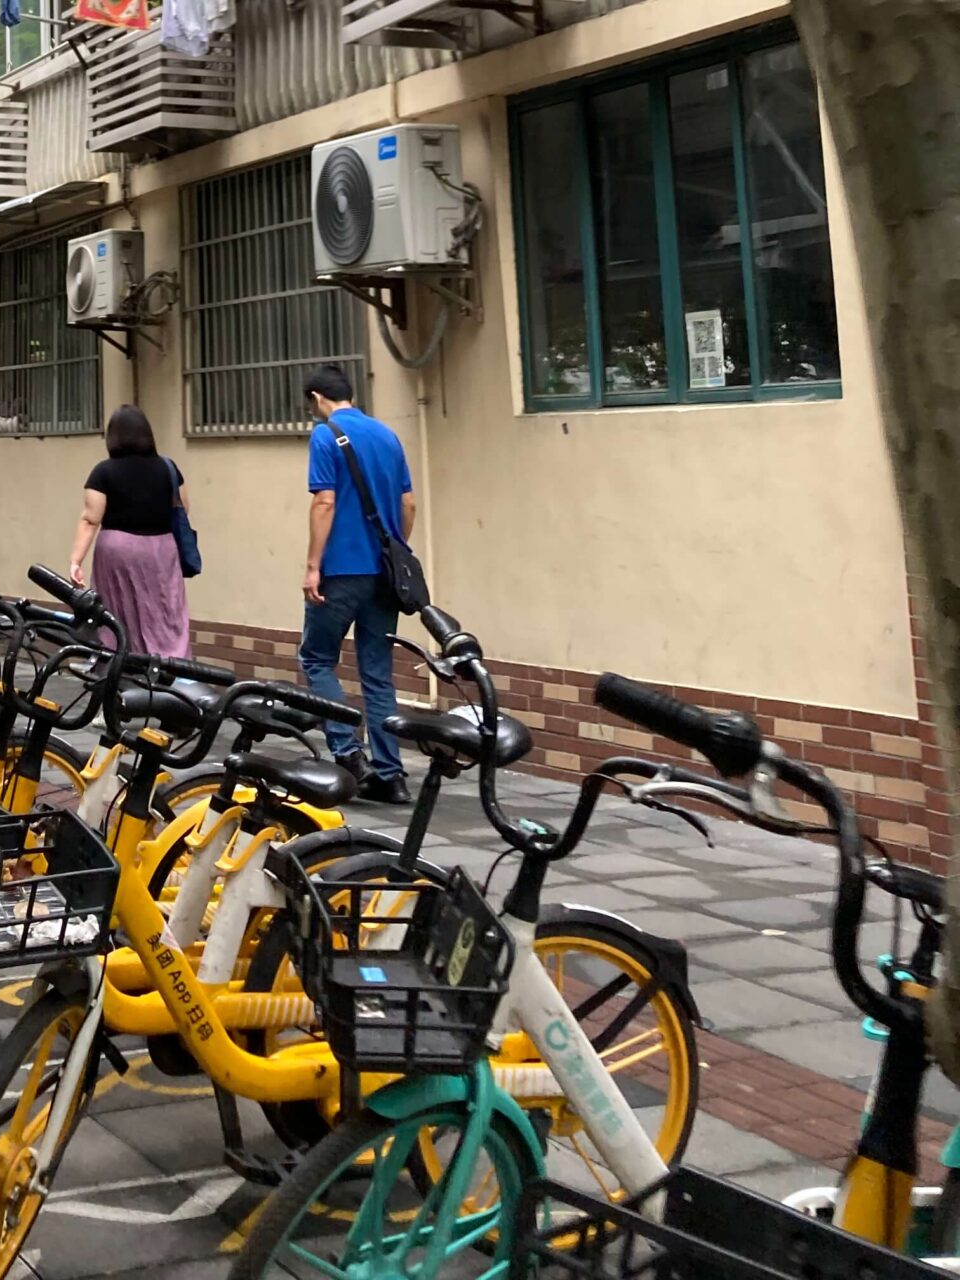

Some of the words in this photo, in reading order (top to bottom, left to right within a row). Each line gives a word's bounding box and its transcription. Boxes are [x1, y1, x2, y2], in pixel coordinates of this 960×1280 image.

[146, 931, 175, 970] 美团
[168, 970, 192, 1004] App
[186, 1004, 214, 1042] 扫码
